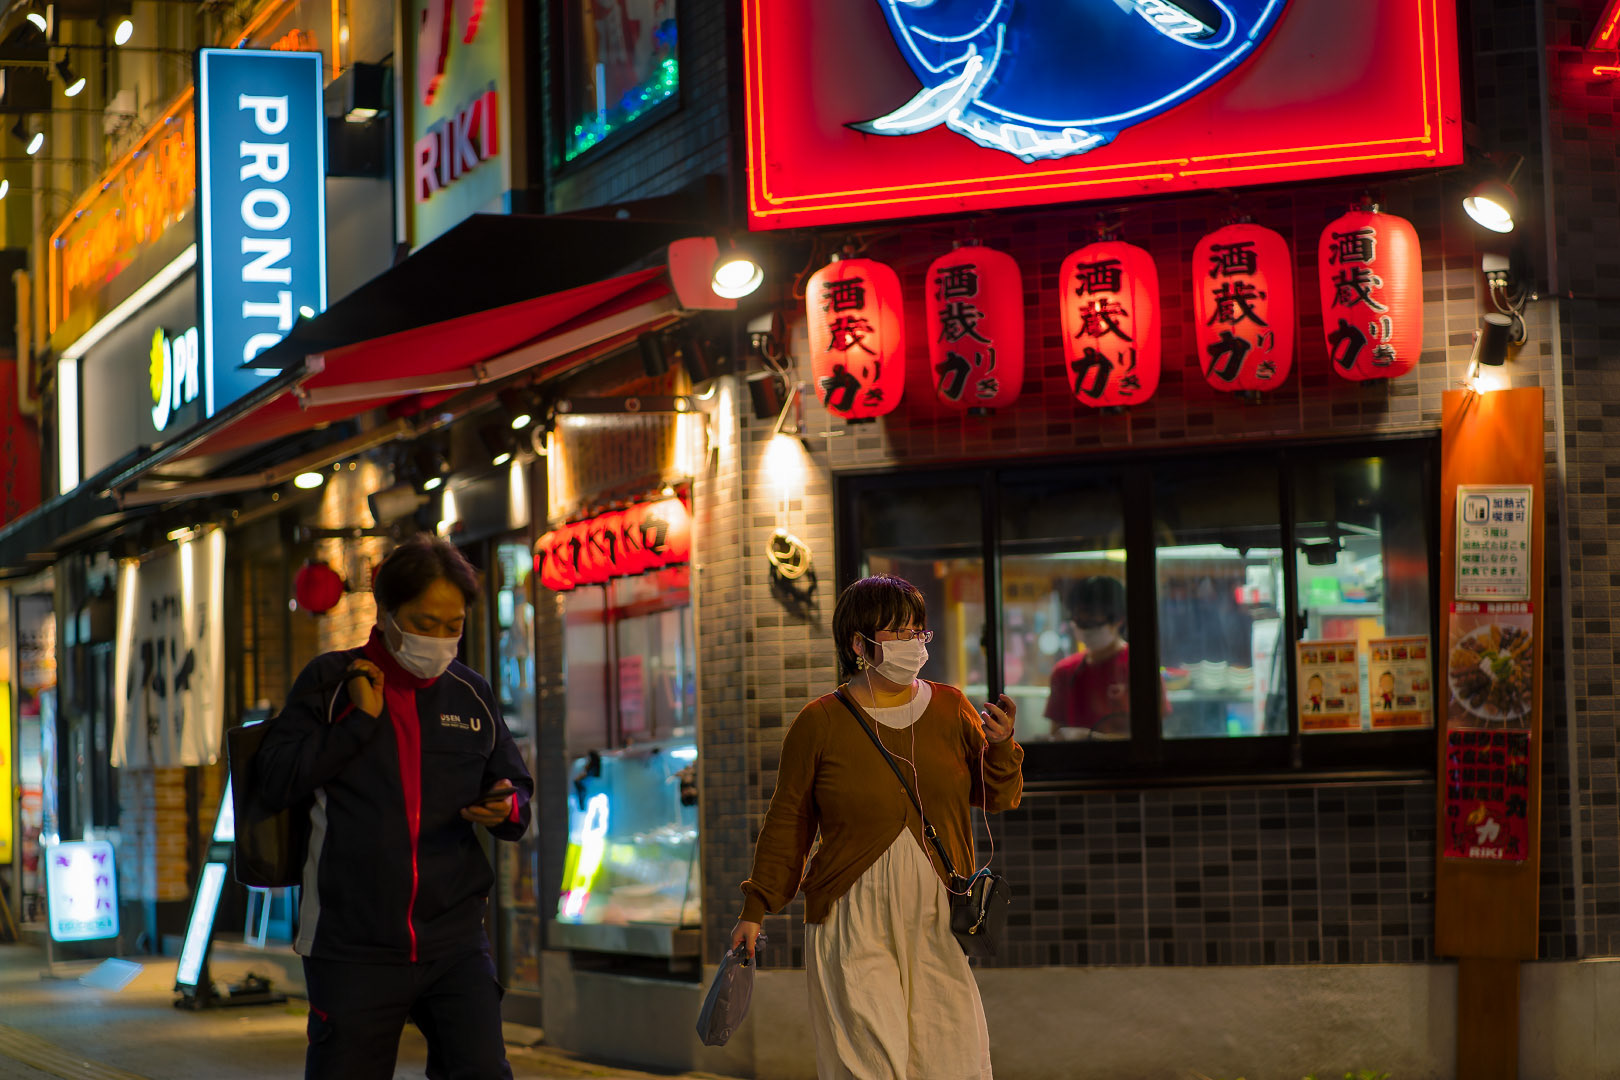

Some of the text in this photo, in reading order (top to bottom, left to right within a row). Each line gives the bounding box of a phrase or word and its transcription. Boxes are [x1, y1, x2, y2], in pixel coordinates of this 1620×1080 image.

[414, 89, 498, 204] RIKI
[1493, 497, 1526, 509] 加熱式
[440, 713, 461, 722] USEN
[470, 717, 481, 731] U
